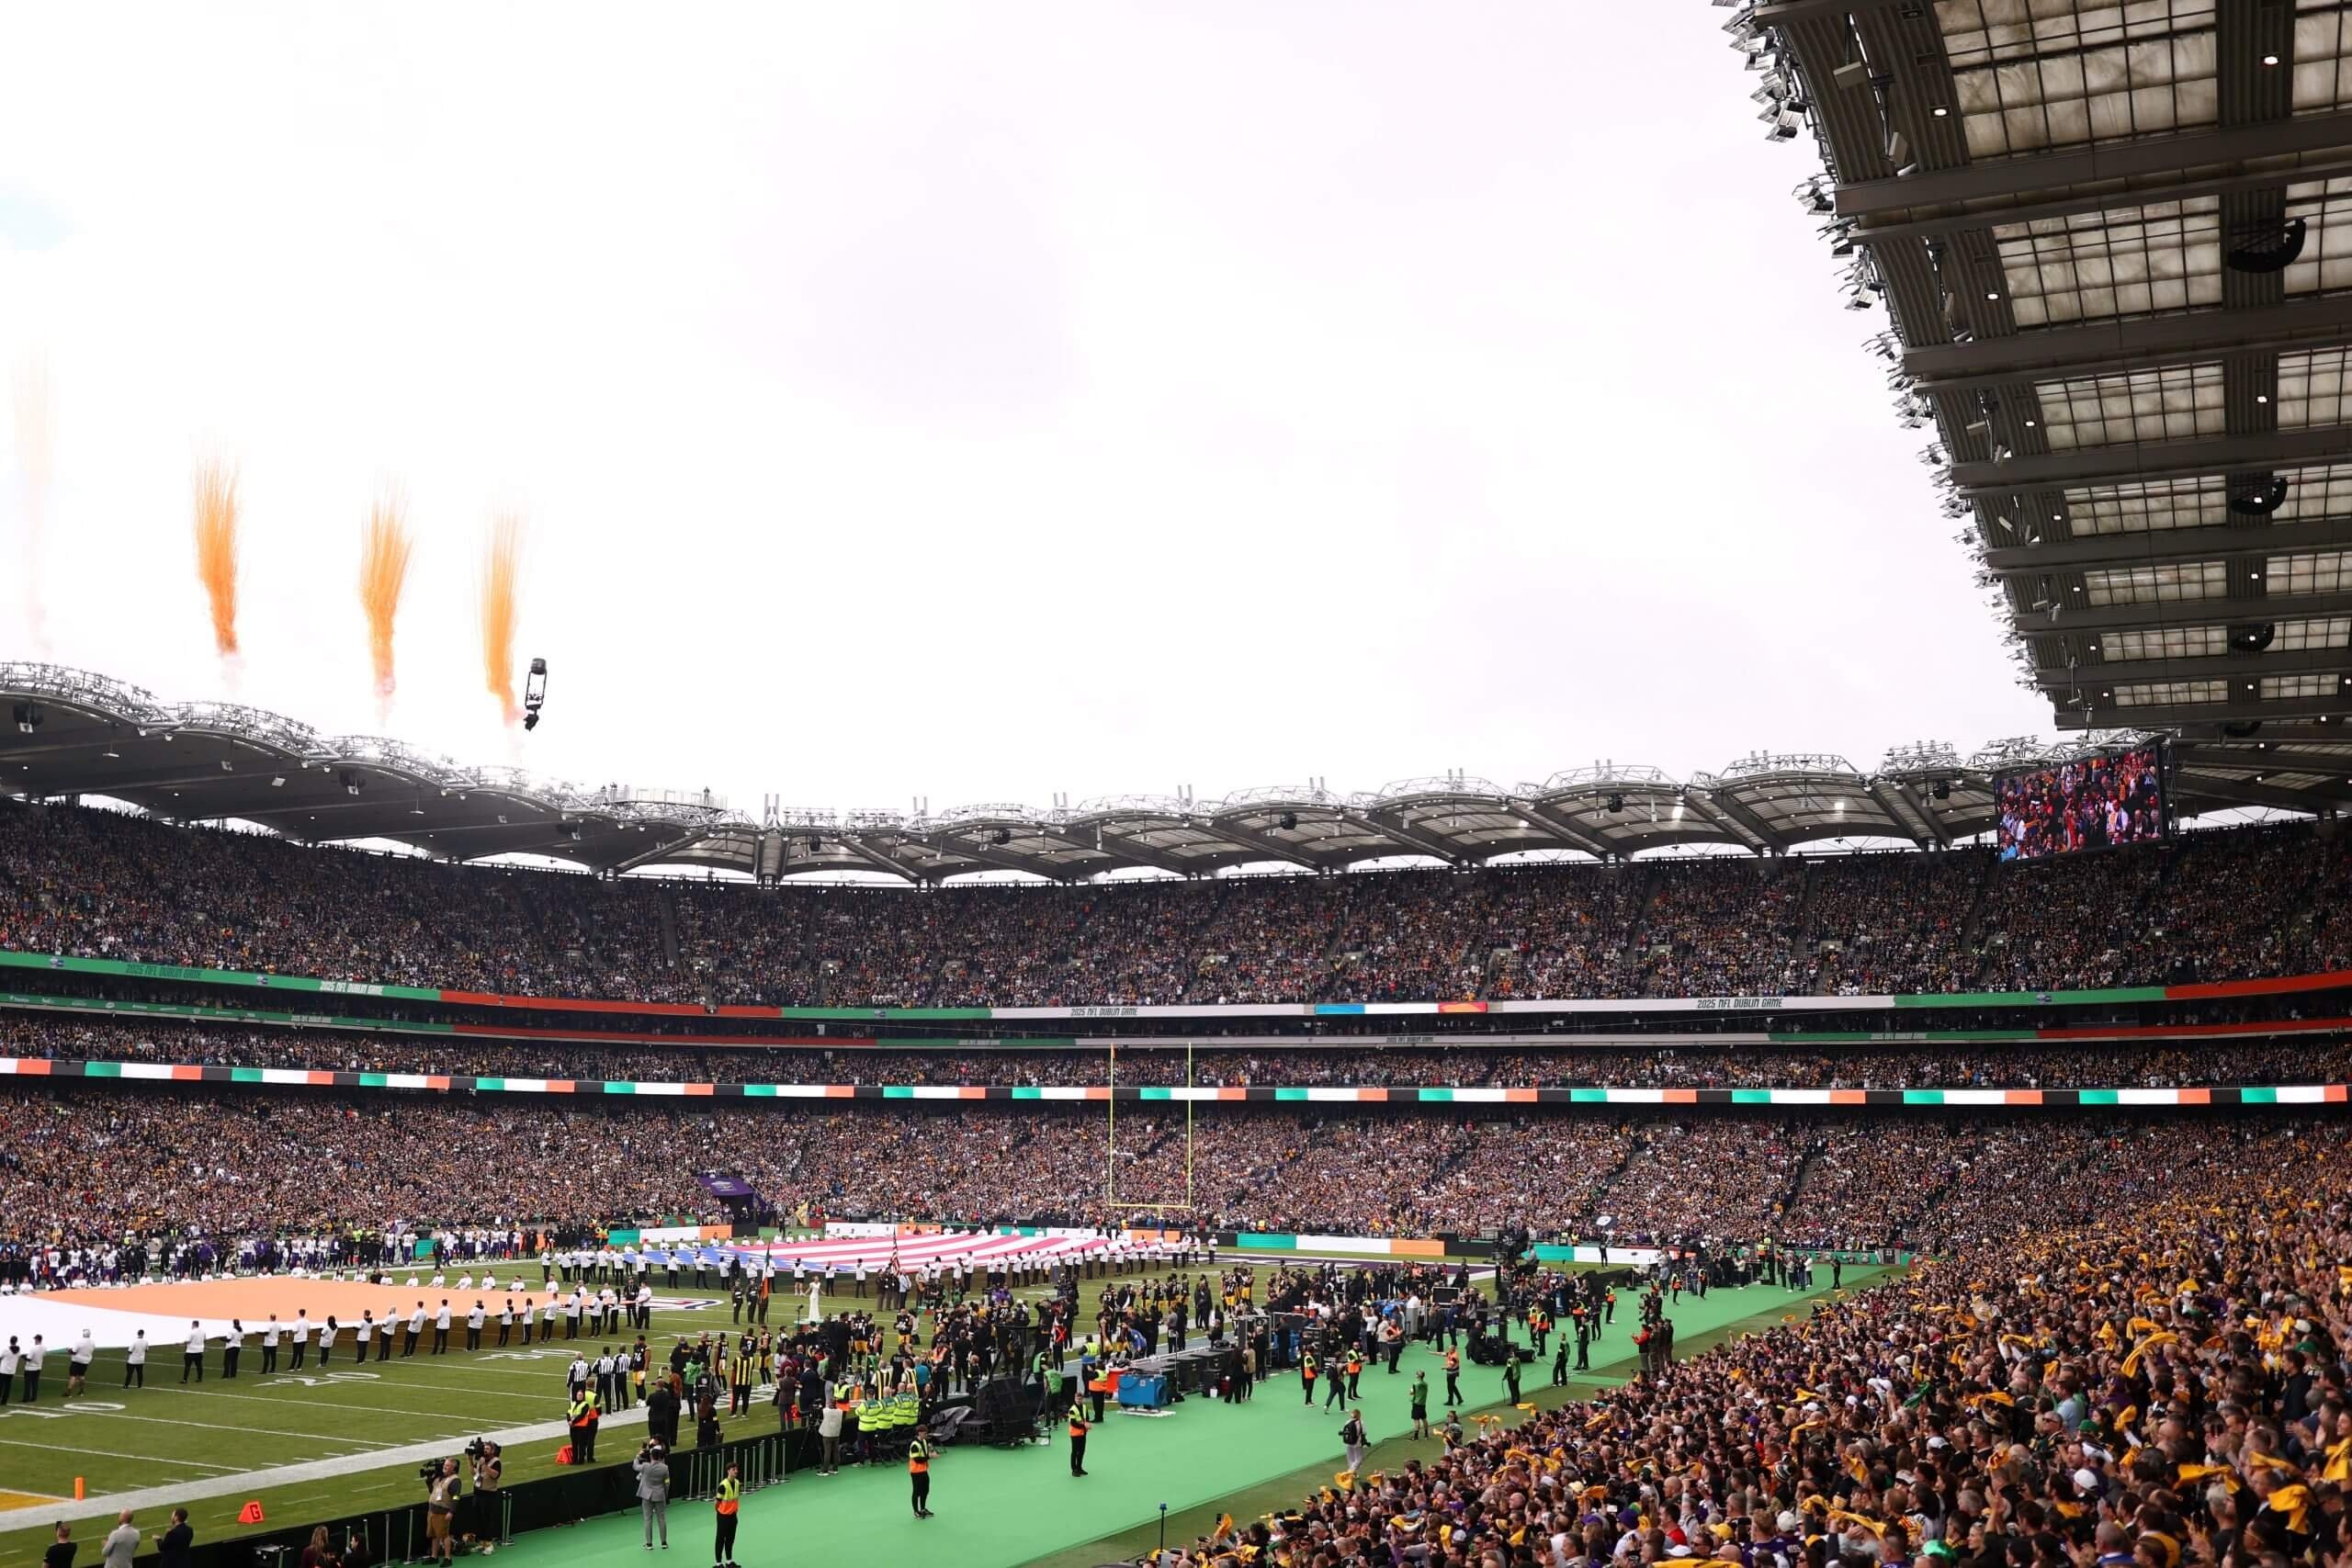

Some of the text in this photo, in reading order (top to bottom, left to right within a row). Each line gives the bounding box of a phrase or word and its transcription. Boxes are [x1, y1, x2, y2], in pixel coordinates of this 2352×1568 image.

[1698, 998, 1783, 1009] 2025 NFL DUBLIN GAME
[1071, 1007, 1138, 1016] 2025 NFL DUBLIN GAME
[273, 1371, 381, 1386] 20
[249, 1504, 261, 1520] G
